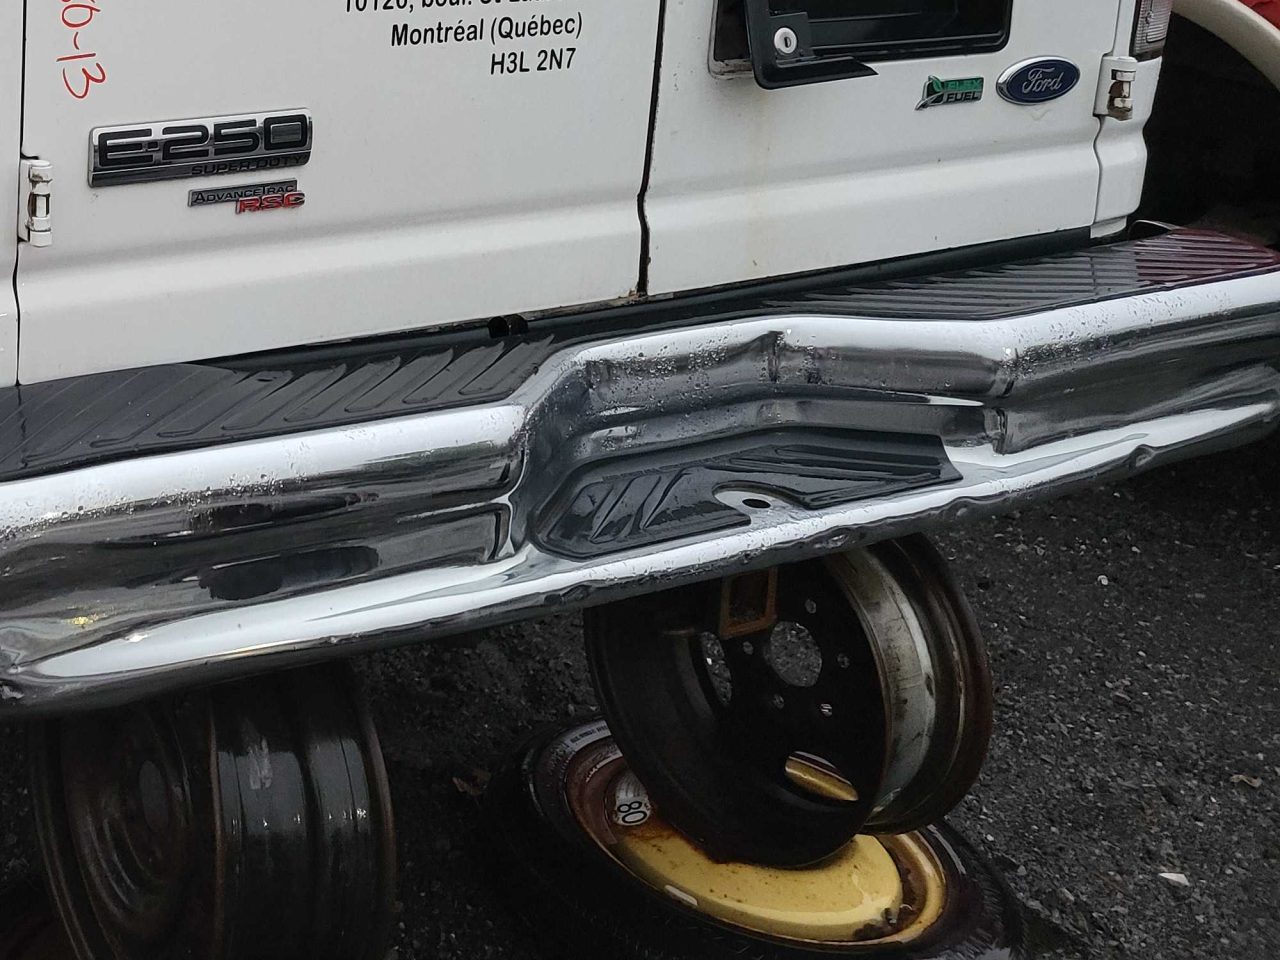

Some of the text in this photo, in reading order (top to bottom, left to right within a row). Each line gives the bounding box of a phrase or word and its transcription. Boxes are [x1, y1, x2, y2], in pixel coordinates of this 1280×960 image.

[390, 12, 583, 47] Montréal (Québec)
[489, 47, 577, 75] H3L 2N7
[1021, 66, 1065, 94] Ford
[946, 91, 980, 103] FUEL
[97, 113, 309, 168] E-250
[236, 191, 306, 215] RSC
